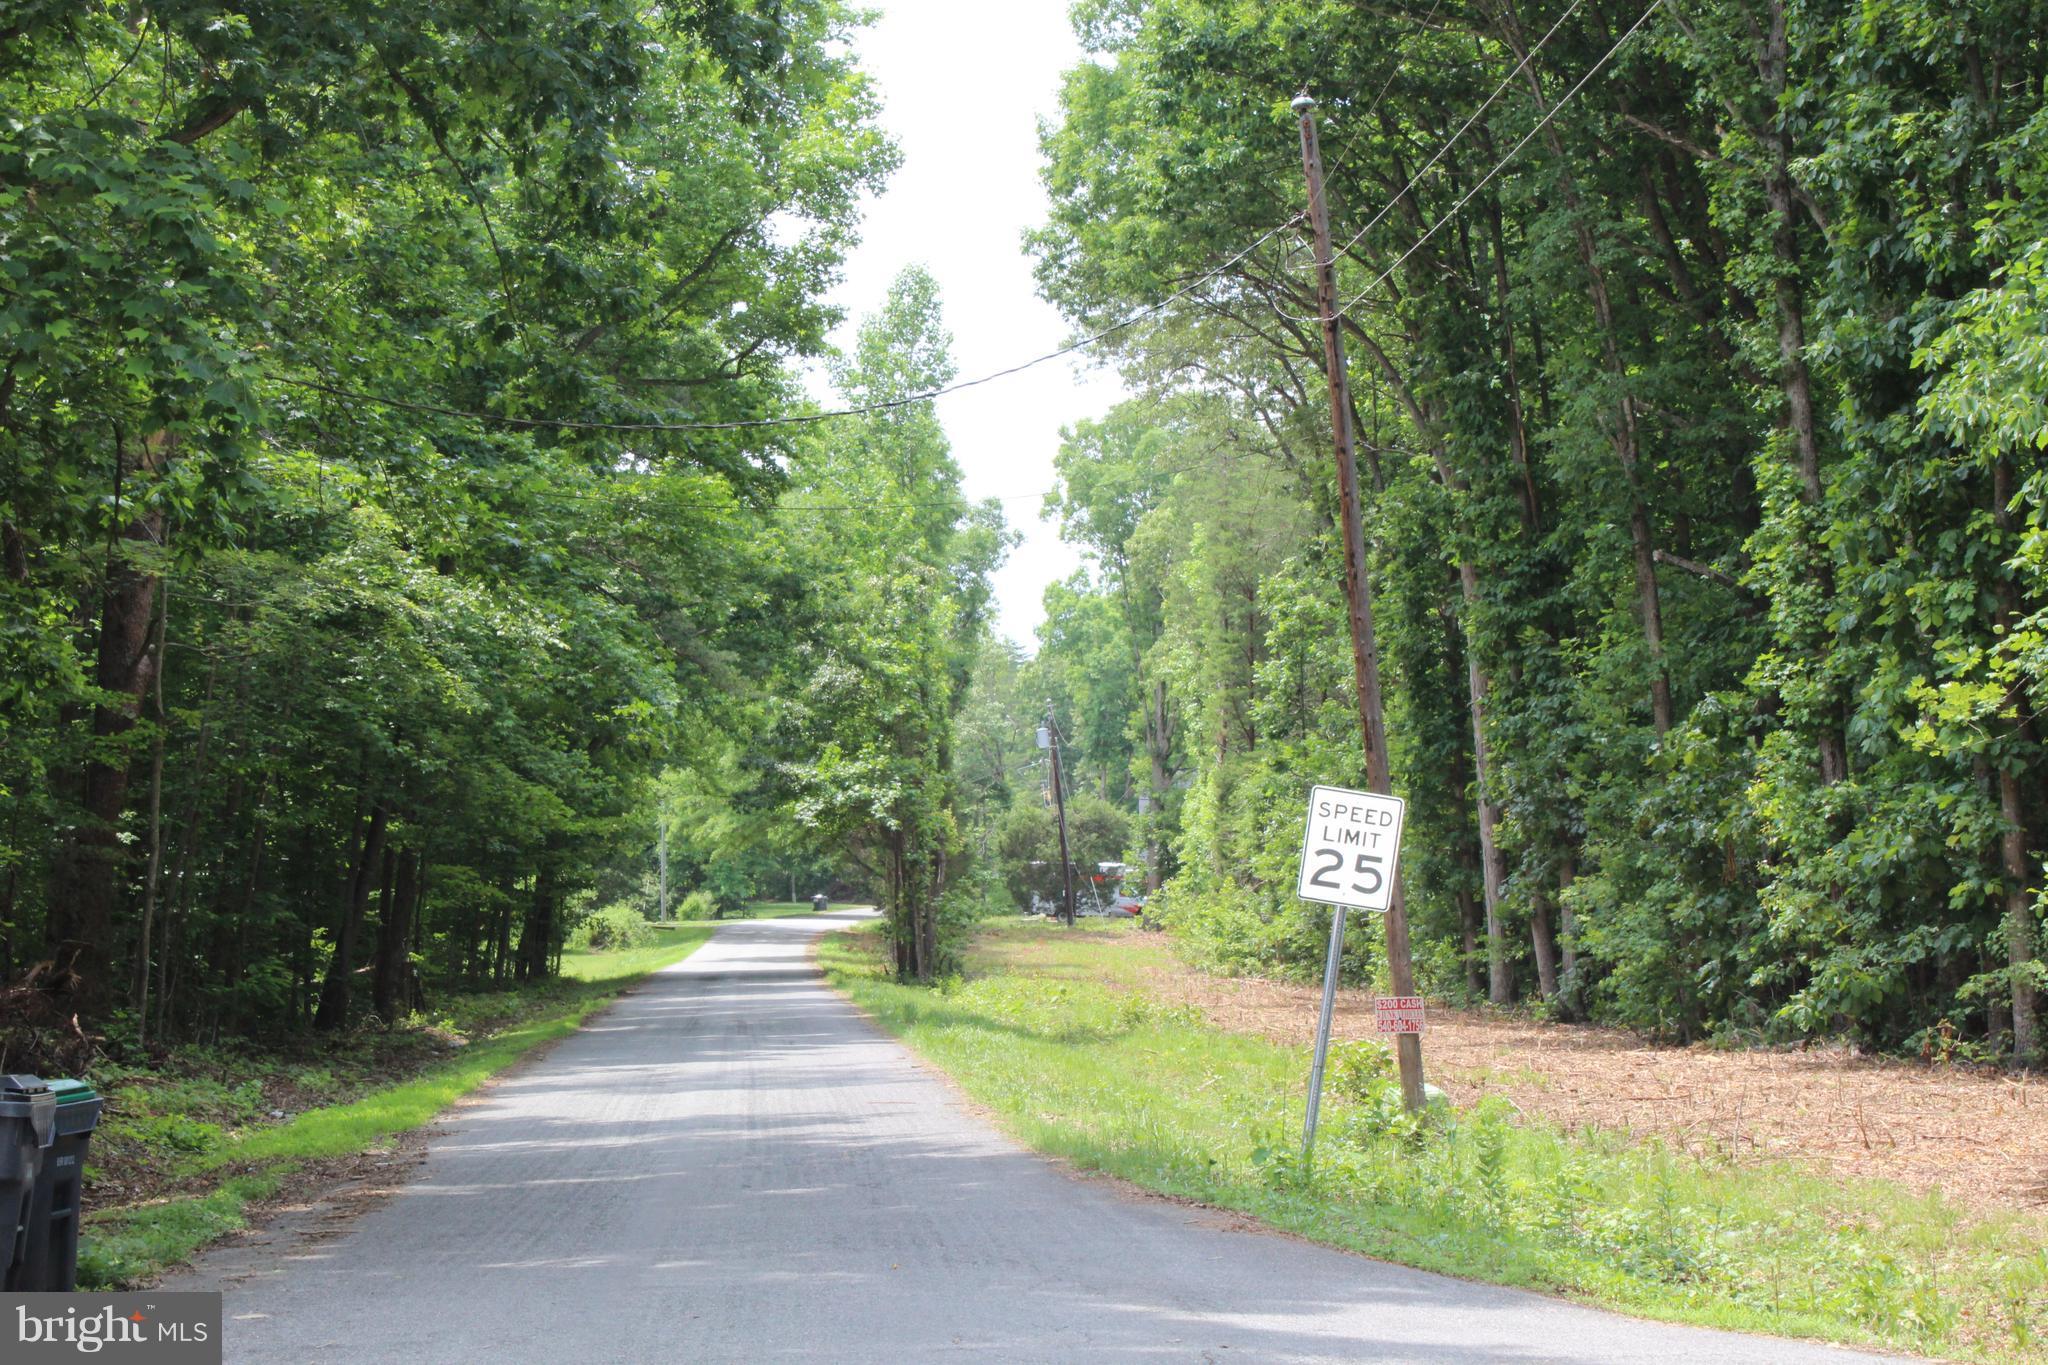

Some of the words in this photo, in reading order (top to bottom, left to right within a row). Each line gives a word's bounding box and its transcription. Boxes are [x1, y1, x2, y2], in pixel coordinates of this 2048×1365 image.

[1318, 801, 1393, 827] SPEED
[1323, 825, 1381, 849] LIMIT
[1310, 848, 1383, 894] 25
[1376, 999, 1398, 1010] $200
[1400, 998, 1423, 1009] CASH
